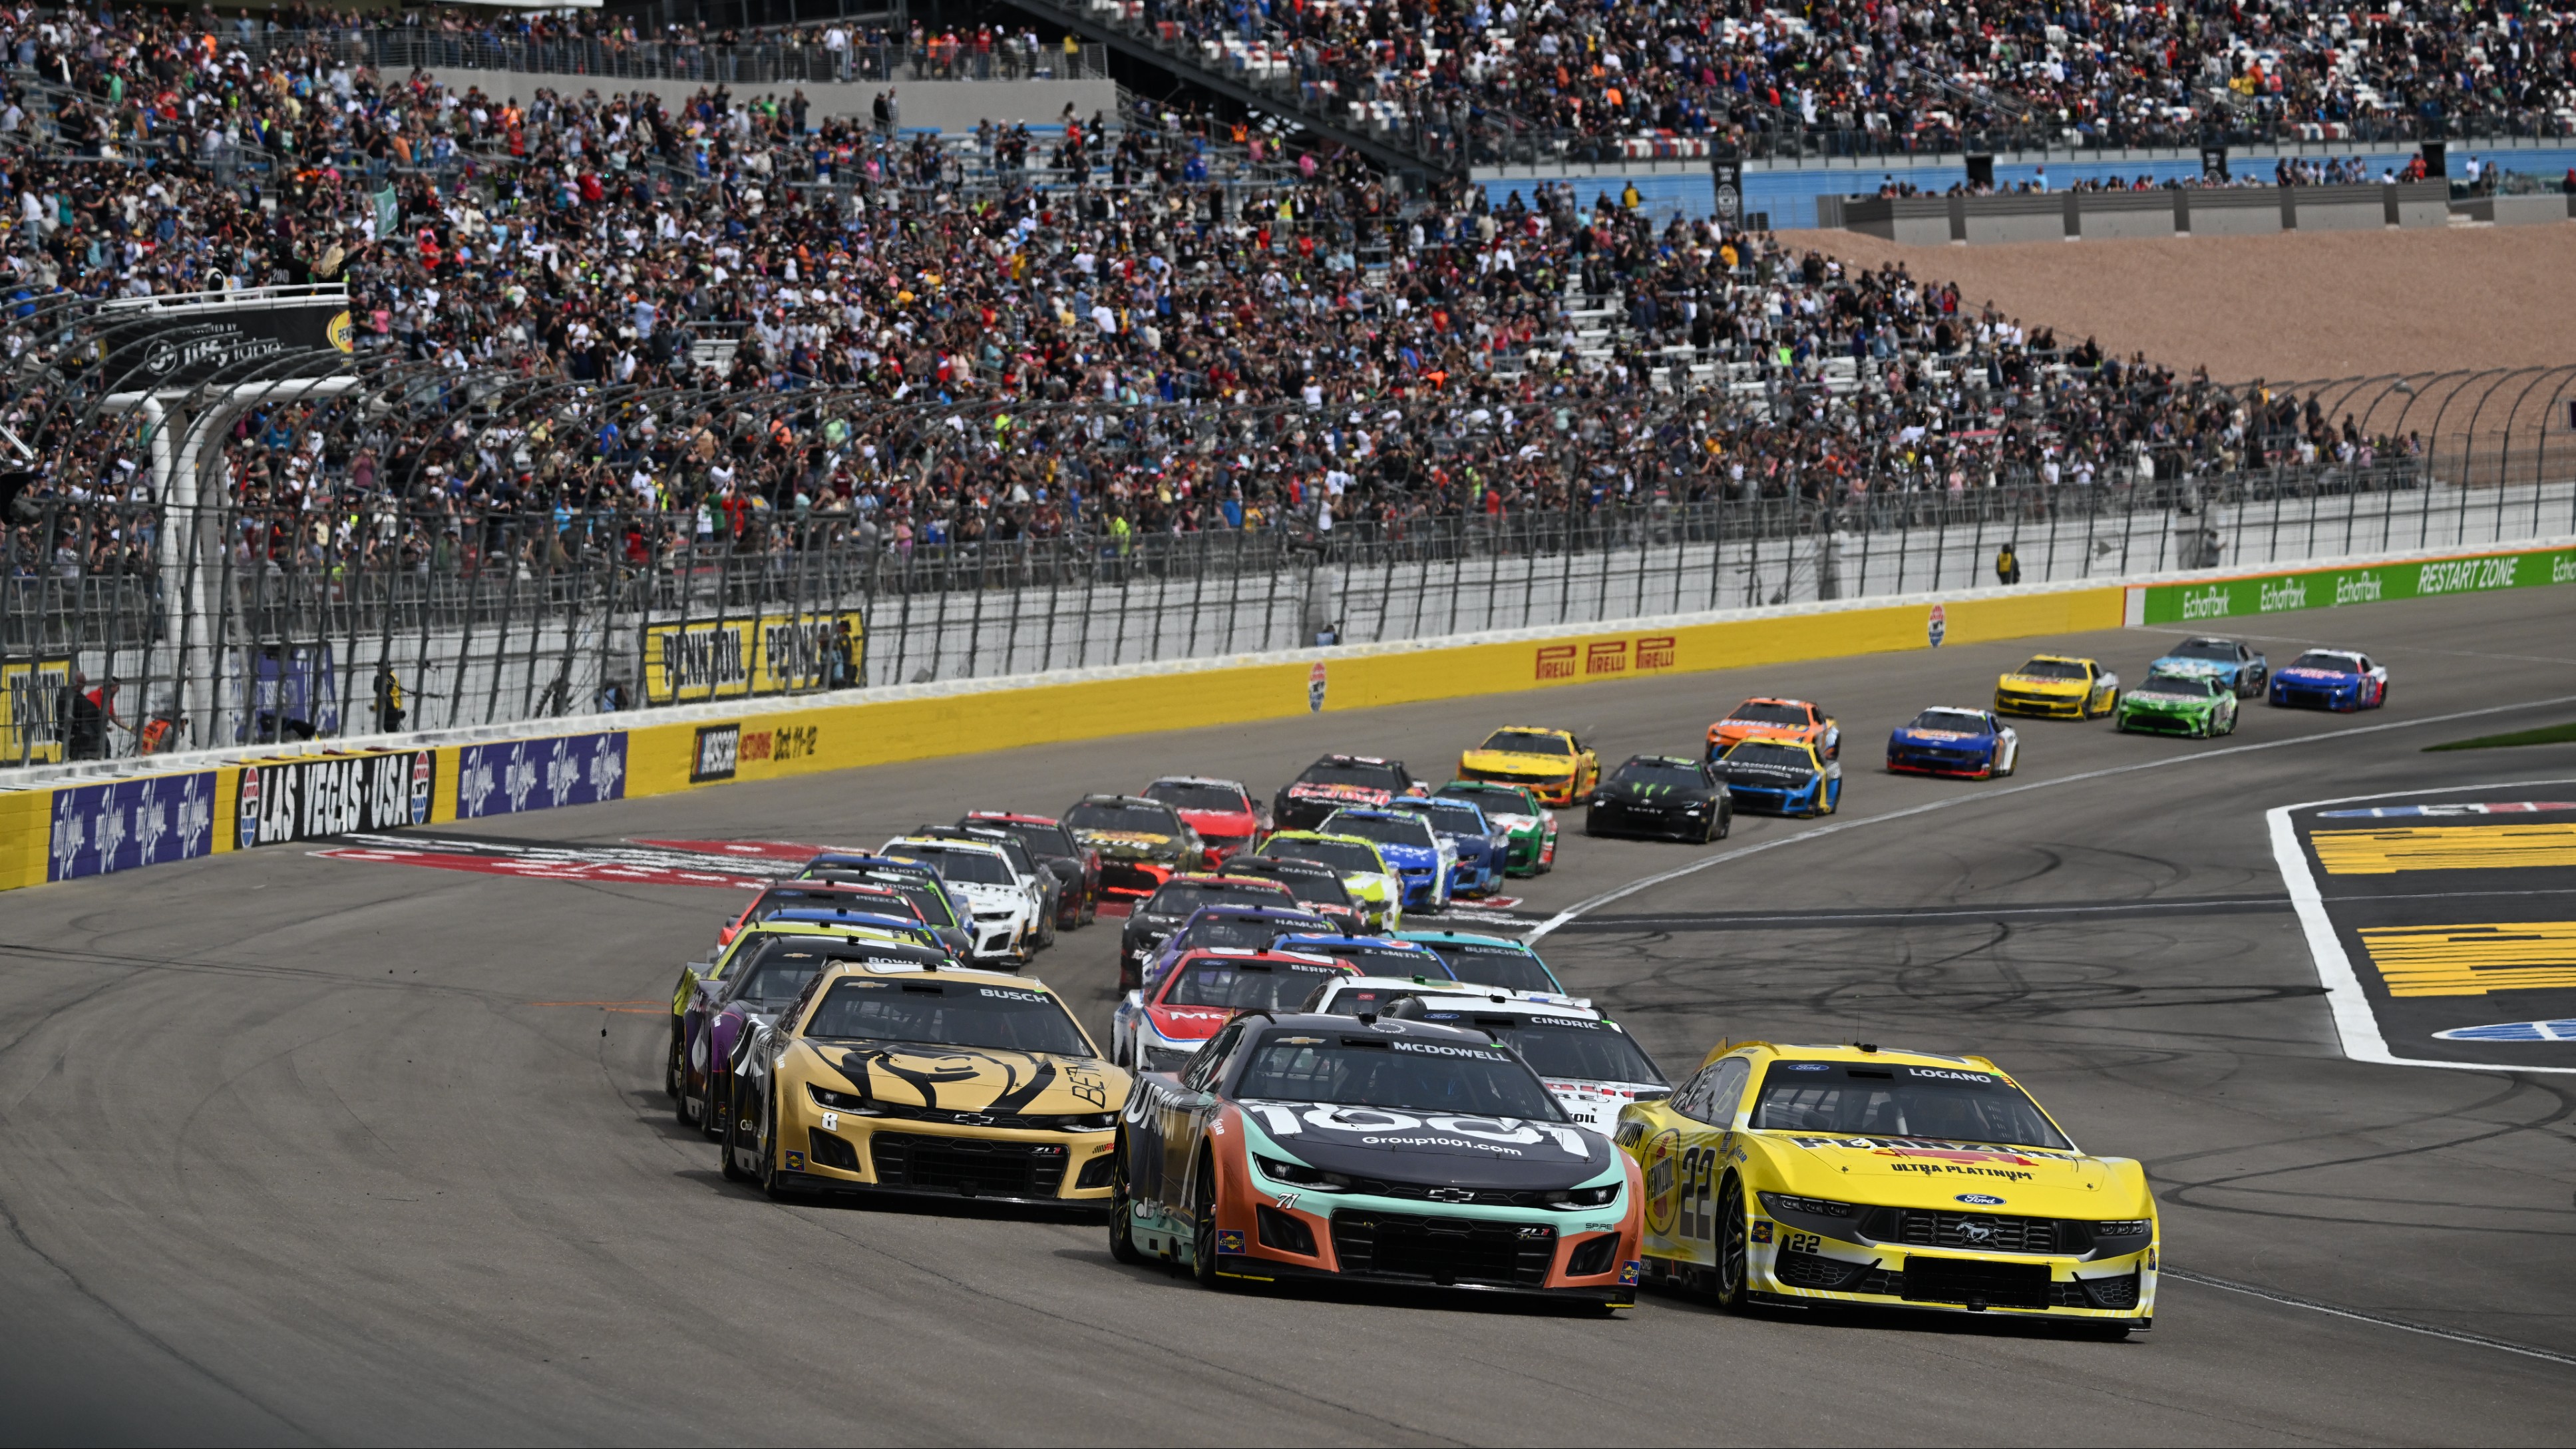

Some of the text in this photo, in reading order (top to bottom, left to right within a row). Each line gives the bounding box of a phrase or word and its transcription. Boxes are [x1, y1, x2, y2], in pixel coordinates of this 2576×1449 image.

[2417, 556, 2519, 594] RESTART ZONE
[2261, 577, 2306, 612] EchoPark
[2336, 570, 2382, 604] EchoPark
[2183, 585, 2229, 619] EchoPark
[1536, 644, 1576, 680] PIRELLI
[1586, 640, 1626, 675] PIRELLI
[1636, 636, 1676, 670] PIRELLI
[260, 764, 297, 842] LAS
[303, 759, 363, 837] VEGAS
[371, 754, 408, 829] USA
[878, 866, 923, 876] ELLIOTT
[856, 895, 900, 905] PREECE
[1275, 918, 1327, 931] HAMLIN
[1380, 950, 1420, 959] SMITH
[1291, 964, 1337, 975] BERRY
[980, 988, 1050, 1004] BUSCH
[1531, 1016, 1600, 1030] CINDRIC
[1393, 1041, 1512, 1062] MCDOWELL
[1909, 1068, 1992, 1084] LOGANO
[821, 1112, 839, 1132] 8
[1362, 1135, 1523, 1157] Group1001.com
[1891, 1163, 1944, 1173] ULTRA
[1647, 1155, 1674, 1203] PENNZOIL
[1275, 1191, 1301, 1210] 71
[1679, 1145, 1716, 1241] 22
[1963, 1194, 1996, 1205] Ford
[1791, 1233, 1821, 1254] 22
